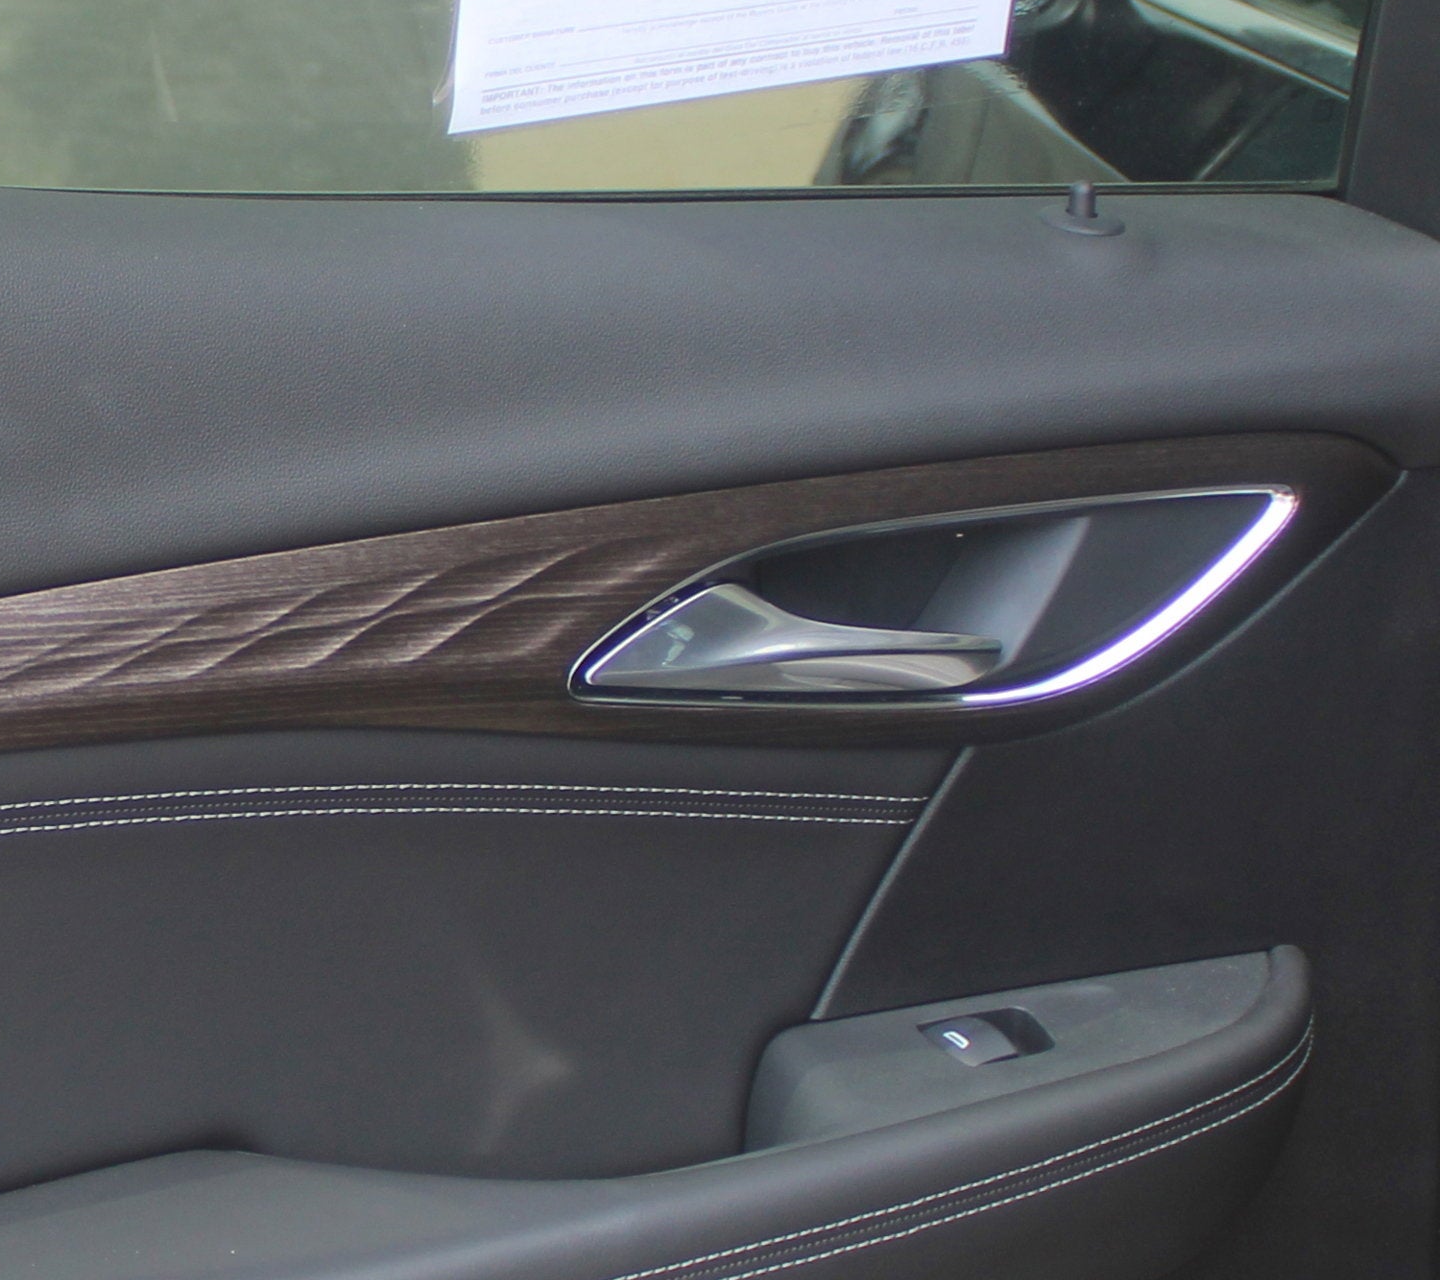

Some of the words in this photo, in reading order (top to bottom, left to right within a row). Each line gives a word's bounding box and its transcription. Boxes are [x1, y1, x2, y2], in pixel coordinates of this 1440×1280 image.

[480, 102, 511, 116] before
[513, 96, 562, 111] consumer
[564, 87, 609, 105] purchase
[611, 82, 648, 98] (except
[650, 79, 663, 91] for
[665, 75, 705, 90] purpose
[707, 71, 718, 82] of
[782, 61, 787, 71] is
[790, 62, 795, 70] a
[797, 54, 838, 69] violation
[841, 52, 850, 63] of
[852, 47, 885, 61] federal
[481, 84, 544, 102] IMPORTANT:
[548, 81, 564, 93] The
[567, 73, 622, 90] information
[624, 72, 637, 81] on
[639, 67, 657, 79] this
[660, 64, 683, 76] form
[685, 62, 694, 73] is
[695, 59, 716, 73] part
[718, 57, 727, 68] of
[729, 56, 748, 68] any
[750, 48, 788, 63] contract
[791, 46, 801, 57] to
[803, 44, 819, 57] buy
[823, 41, 840, 52] this
[880, 29, 919, 44] Removal
[922, 27, 931, 38] of
[933, 24, 951, 36] this
[953, 21, 975, 33] label
